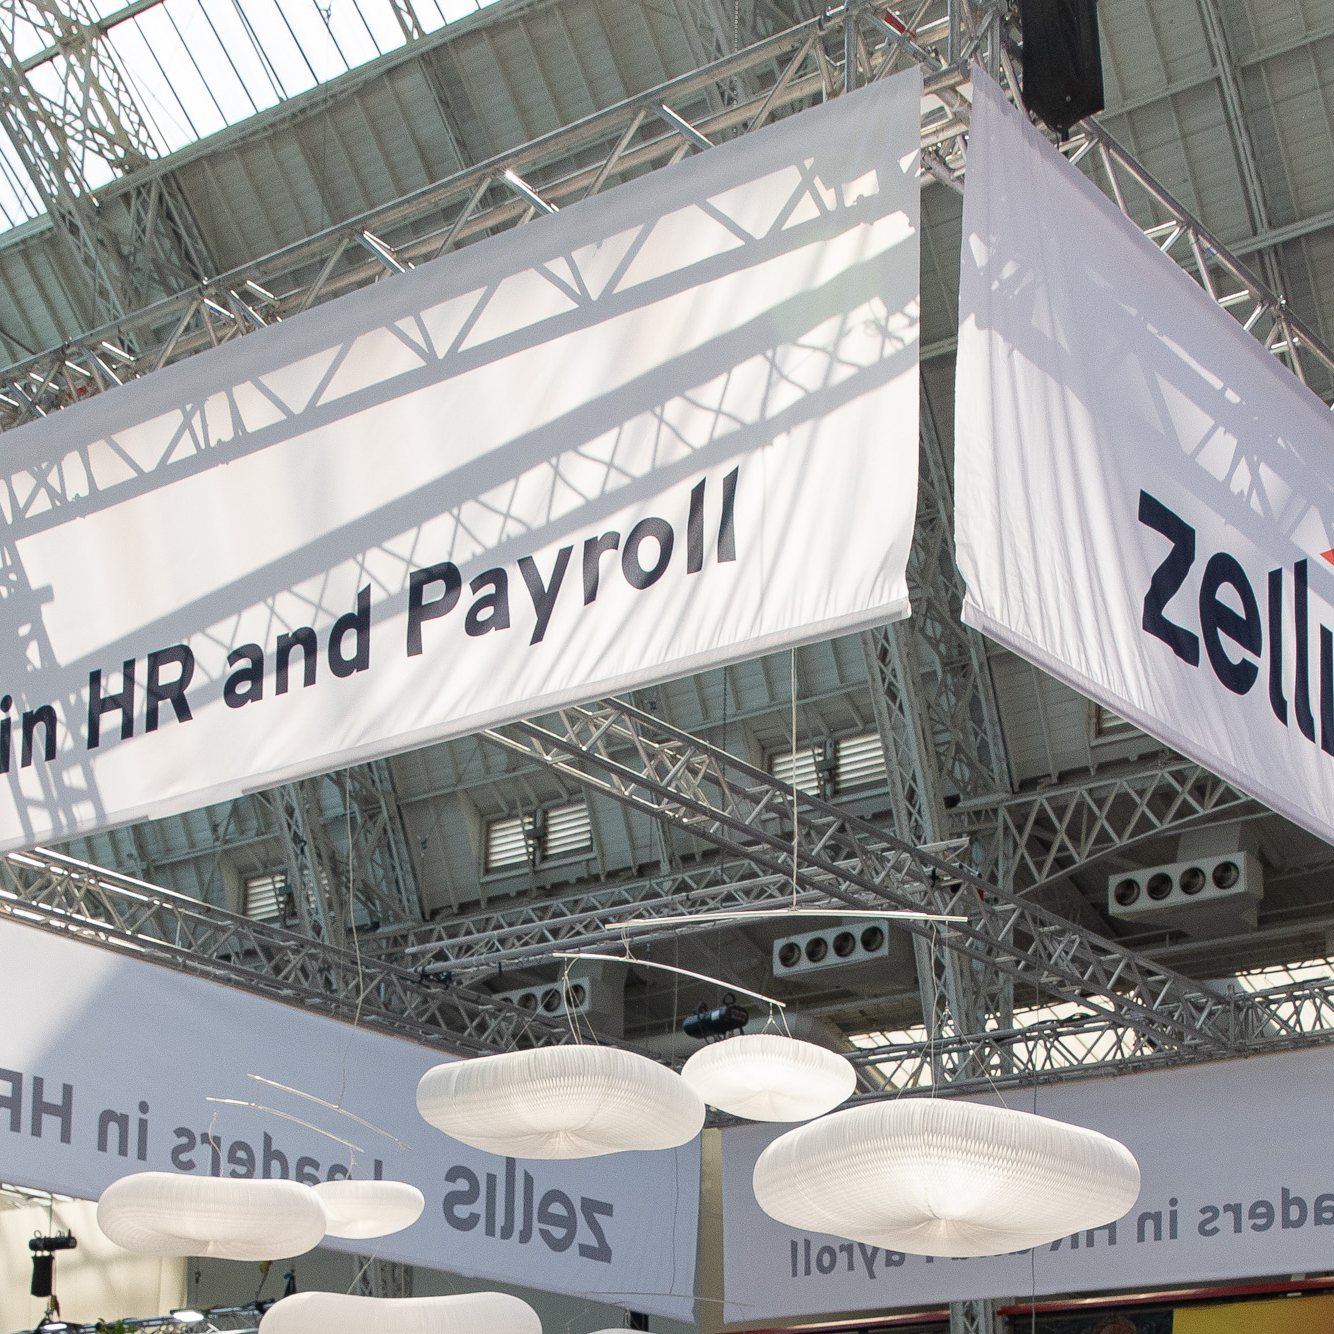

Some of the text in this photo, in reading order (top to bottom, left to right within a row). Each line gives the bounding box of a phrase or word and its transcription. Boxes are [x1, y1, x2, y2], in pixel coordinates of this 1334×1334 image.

[85, 645, 195, 750] HR
[222, 582, 371, 709] and
[405, 466, 740, 658] Payroll
